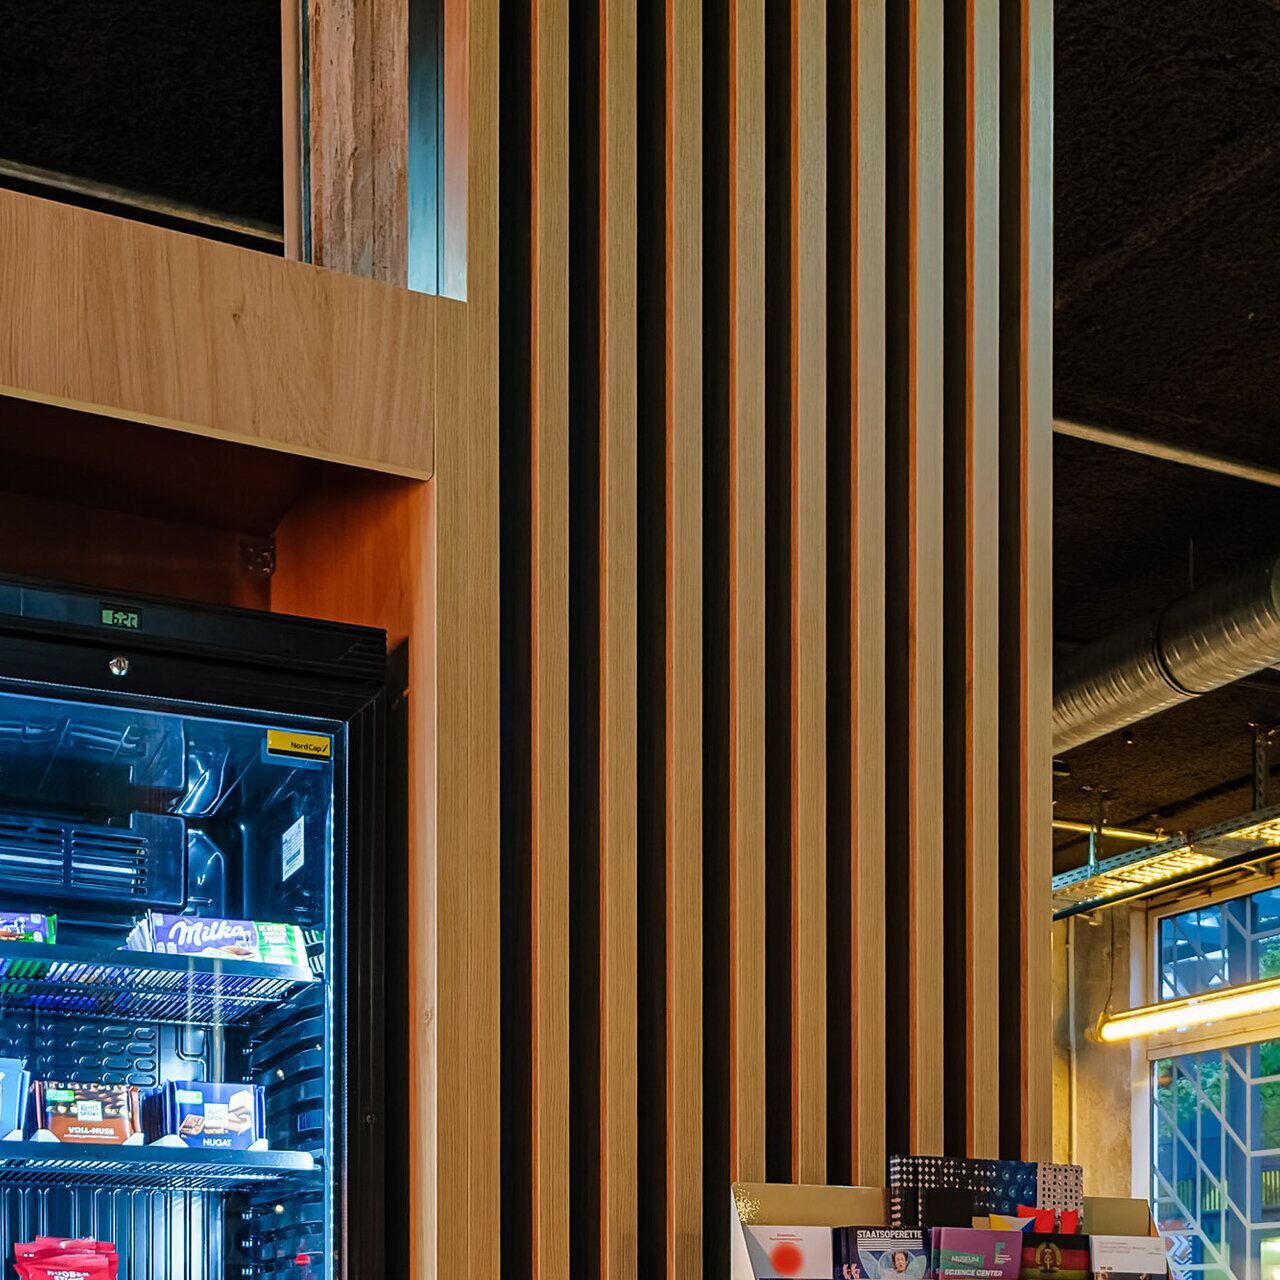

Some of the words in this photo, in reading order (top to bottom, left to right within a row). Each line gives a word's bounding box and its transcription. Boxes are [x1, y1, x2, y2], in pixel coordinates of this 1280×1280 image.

[290, 741, 322, 753] NordCap
[168, 920, 246, 946] Milka
[202, 1138, 232, 1147] NUGAT
[857, 1230, 923, 1239] STAATSOPERETTE
[944, 1268, 975, 1277] SCIENCE
[976, 1269, 1003, 1277] CENTER
